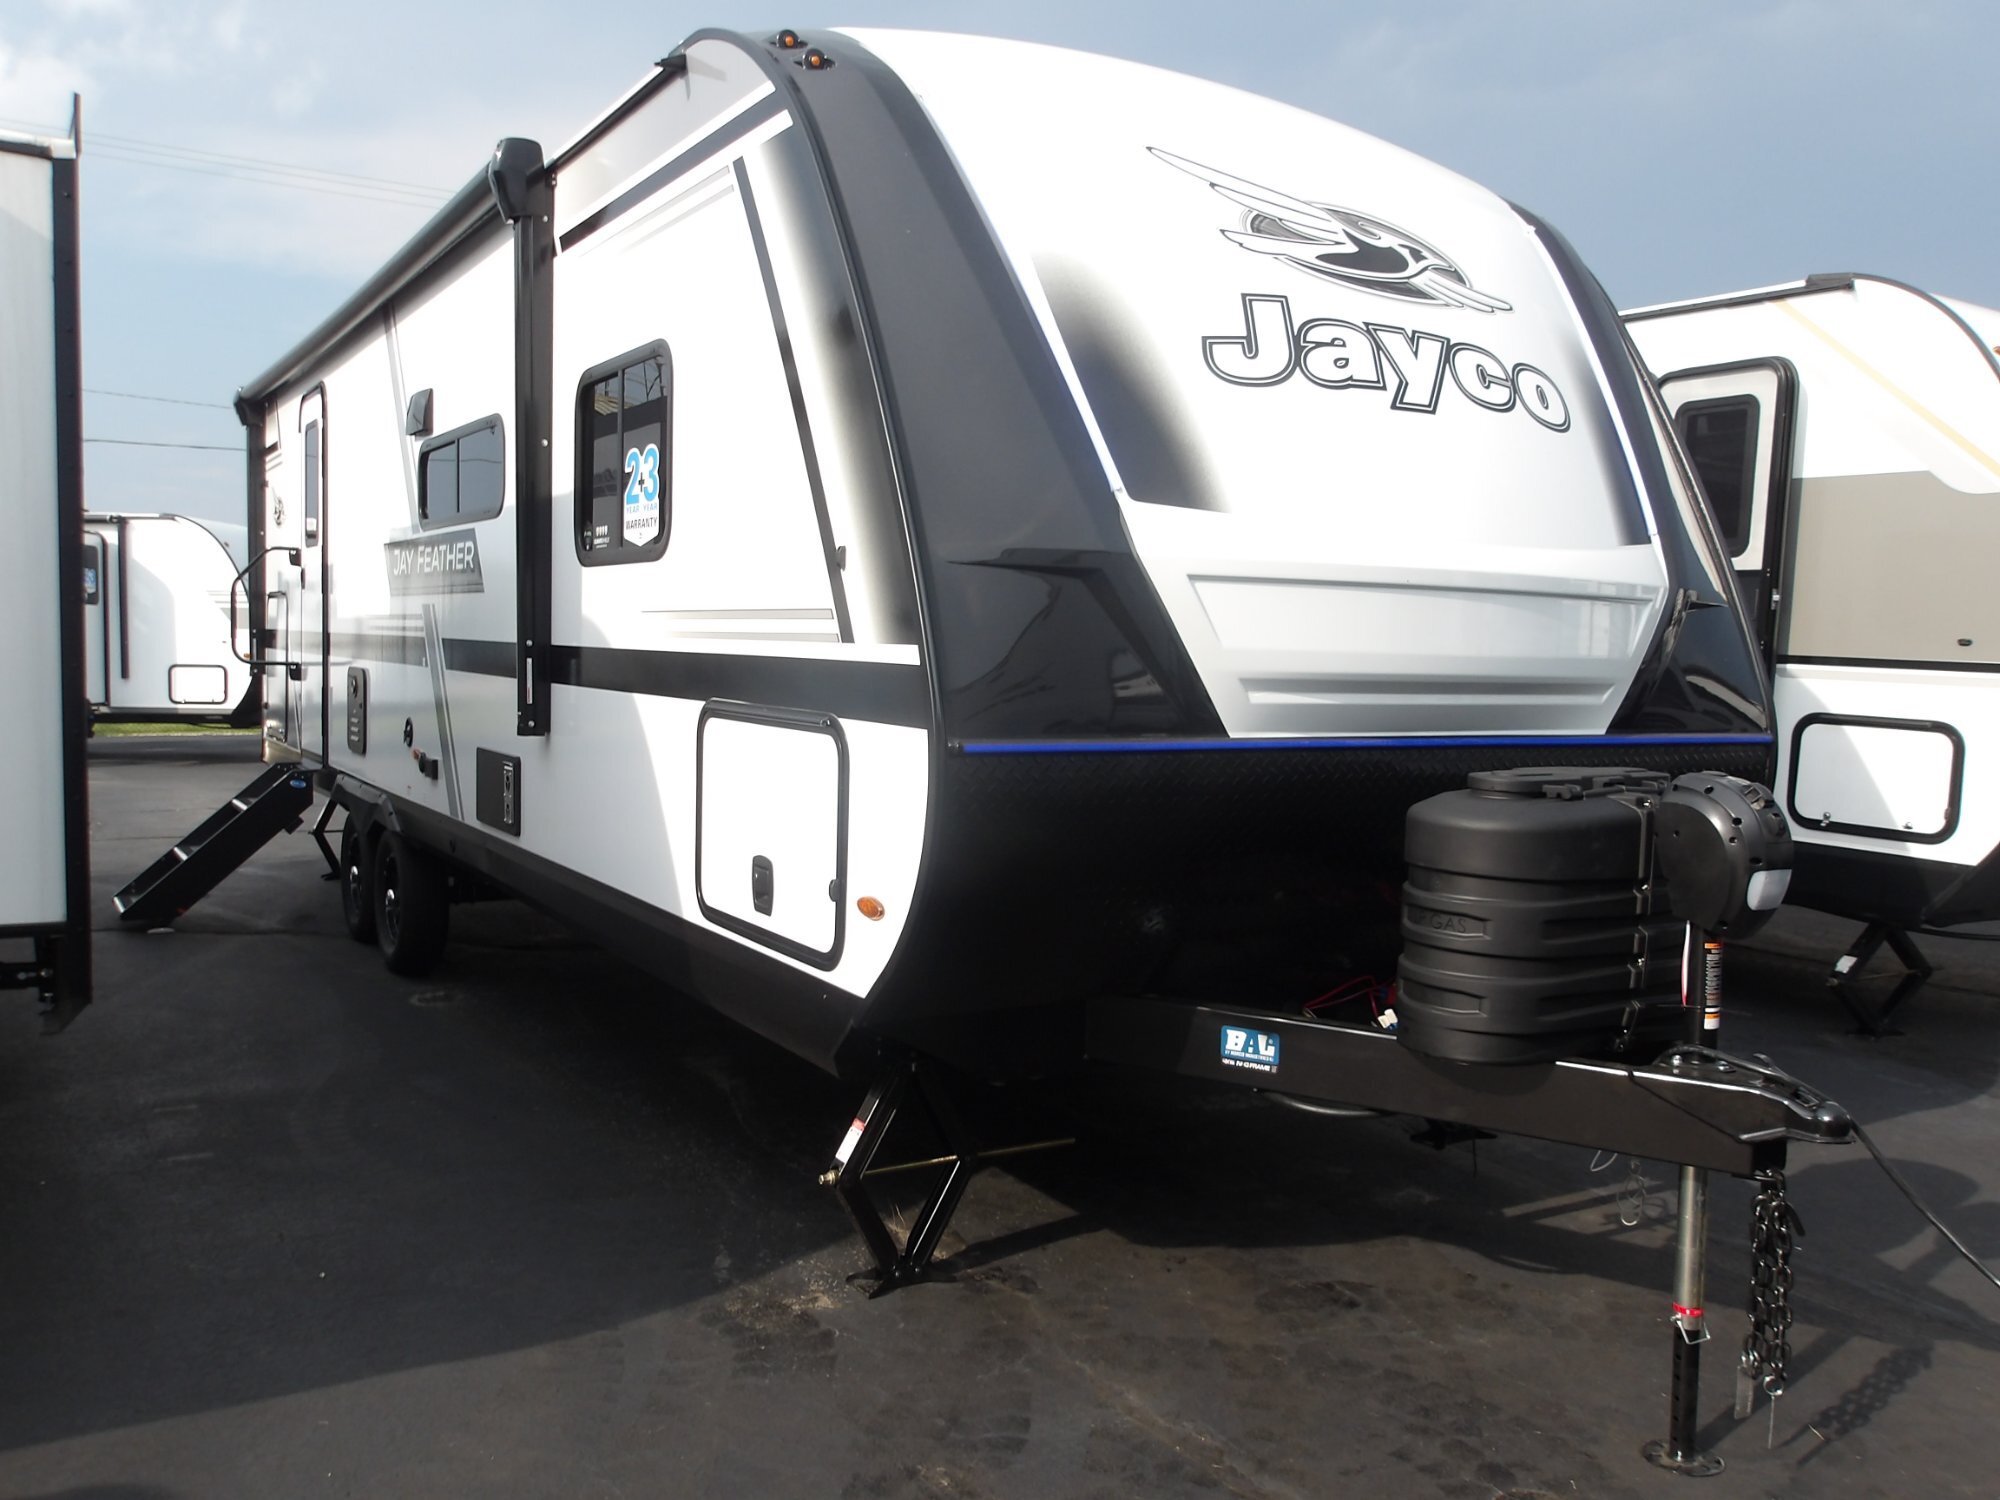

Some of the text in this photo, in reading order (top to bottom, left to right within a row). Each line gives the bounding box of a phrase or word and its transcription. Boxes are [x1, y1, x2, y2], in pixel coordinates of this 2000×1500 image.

[1202, 292, 1570, 433] Jayco
[625, 516, 658, 530] WARRANTY
[393, 541, 475, 576] JAY FEATHER
[1430, 912, 1467, 933] GAS
